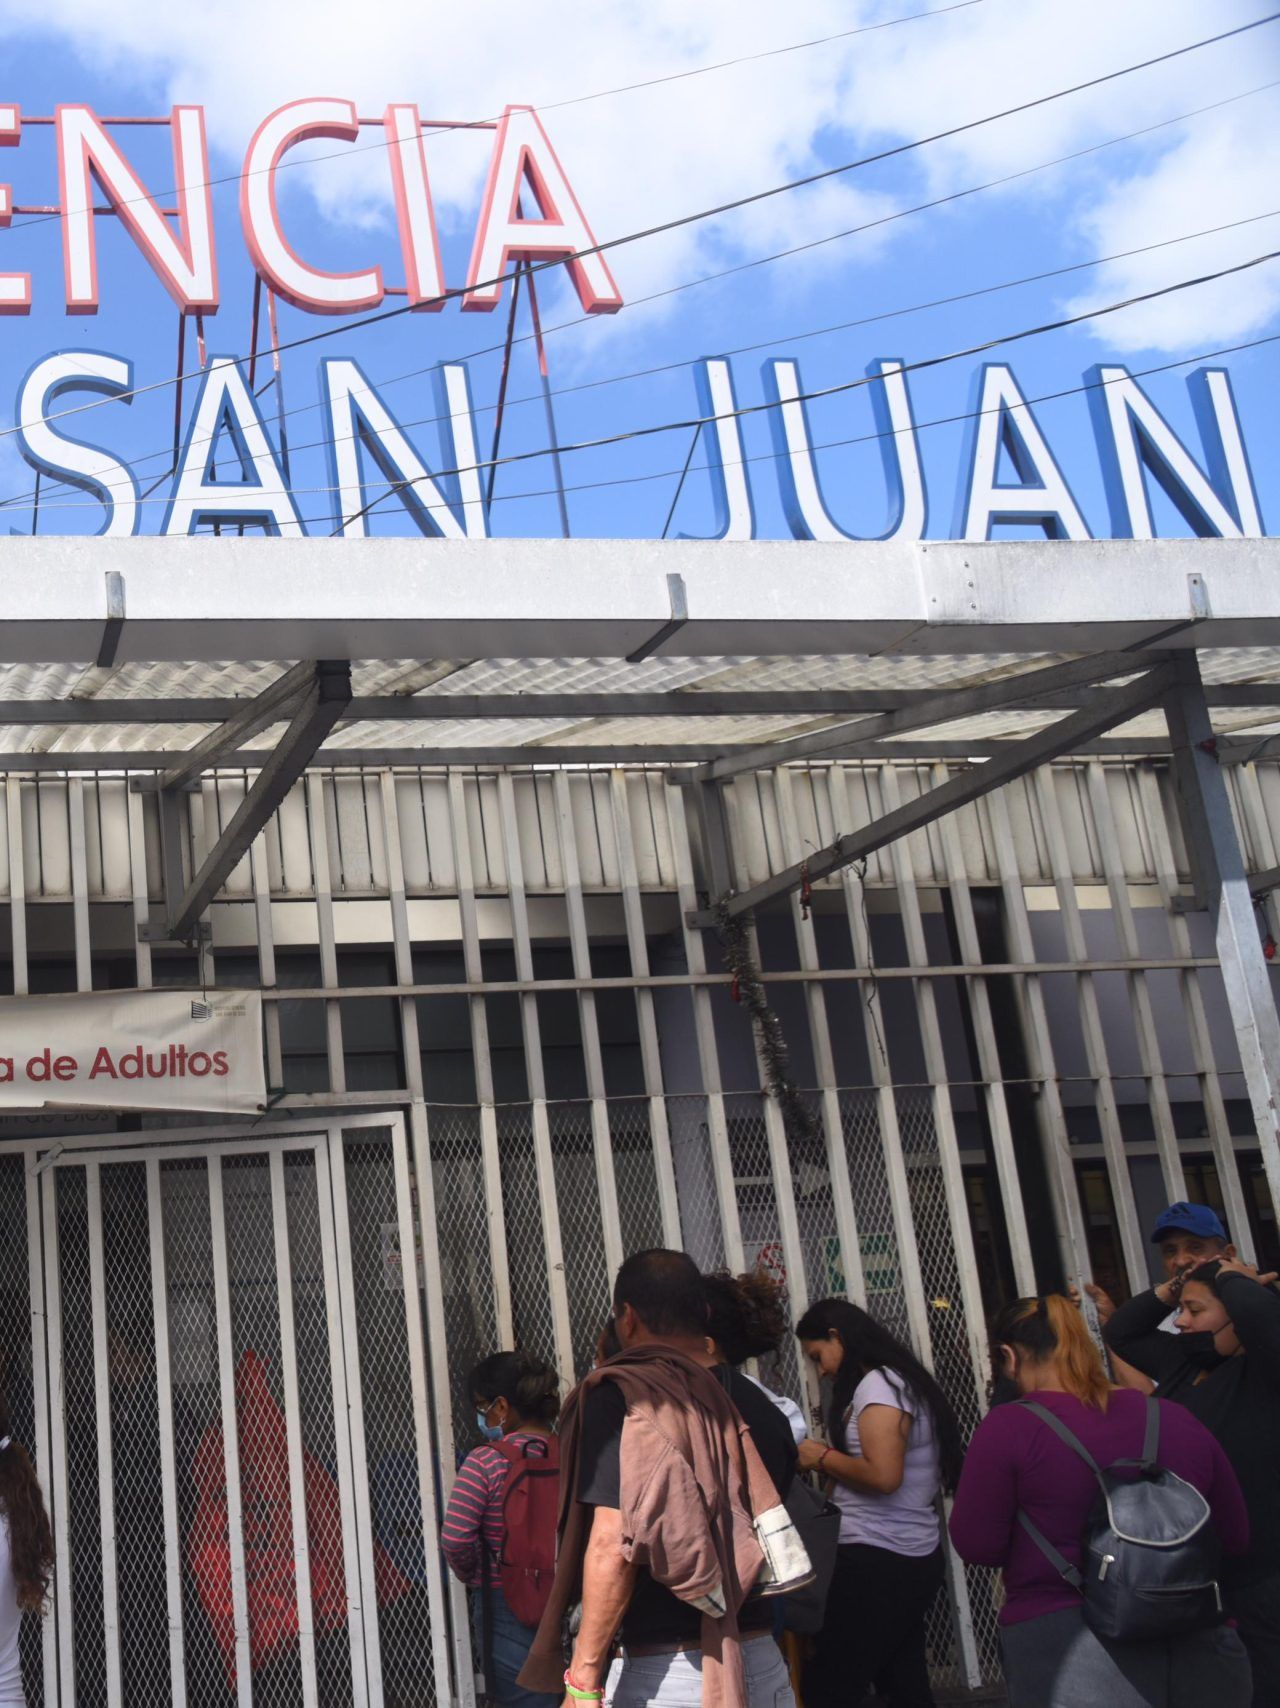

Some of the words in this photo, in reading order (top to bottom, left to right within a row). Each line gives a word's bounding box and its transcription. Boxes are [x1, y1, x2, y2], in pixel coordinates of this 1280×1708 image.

[14, 348, 491, 540] SAN
[679, 355, 1267, 542] JUAN
[25, 1047, 78, 1082] de
[88, 1043, 230, 1080] Adultos
